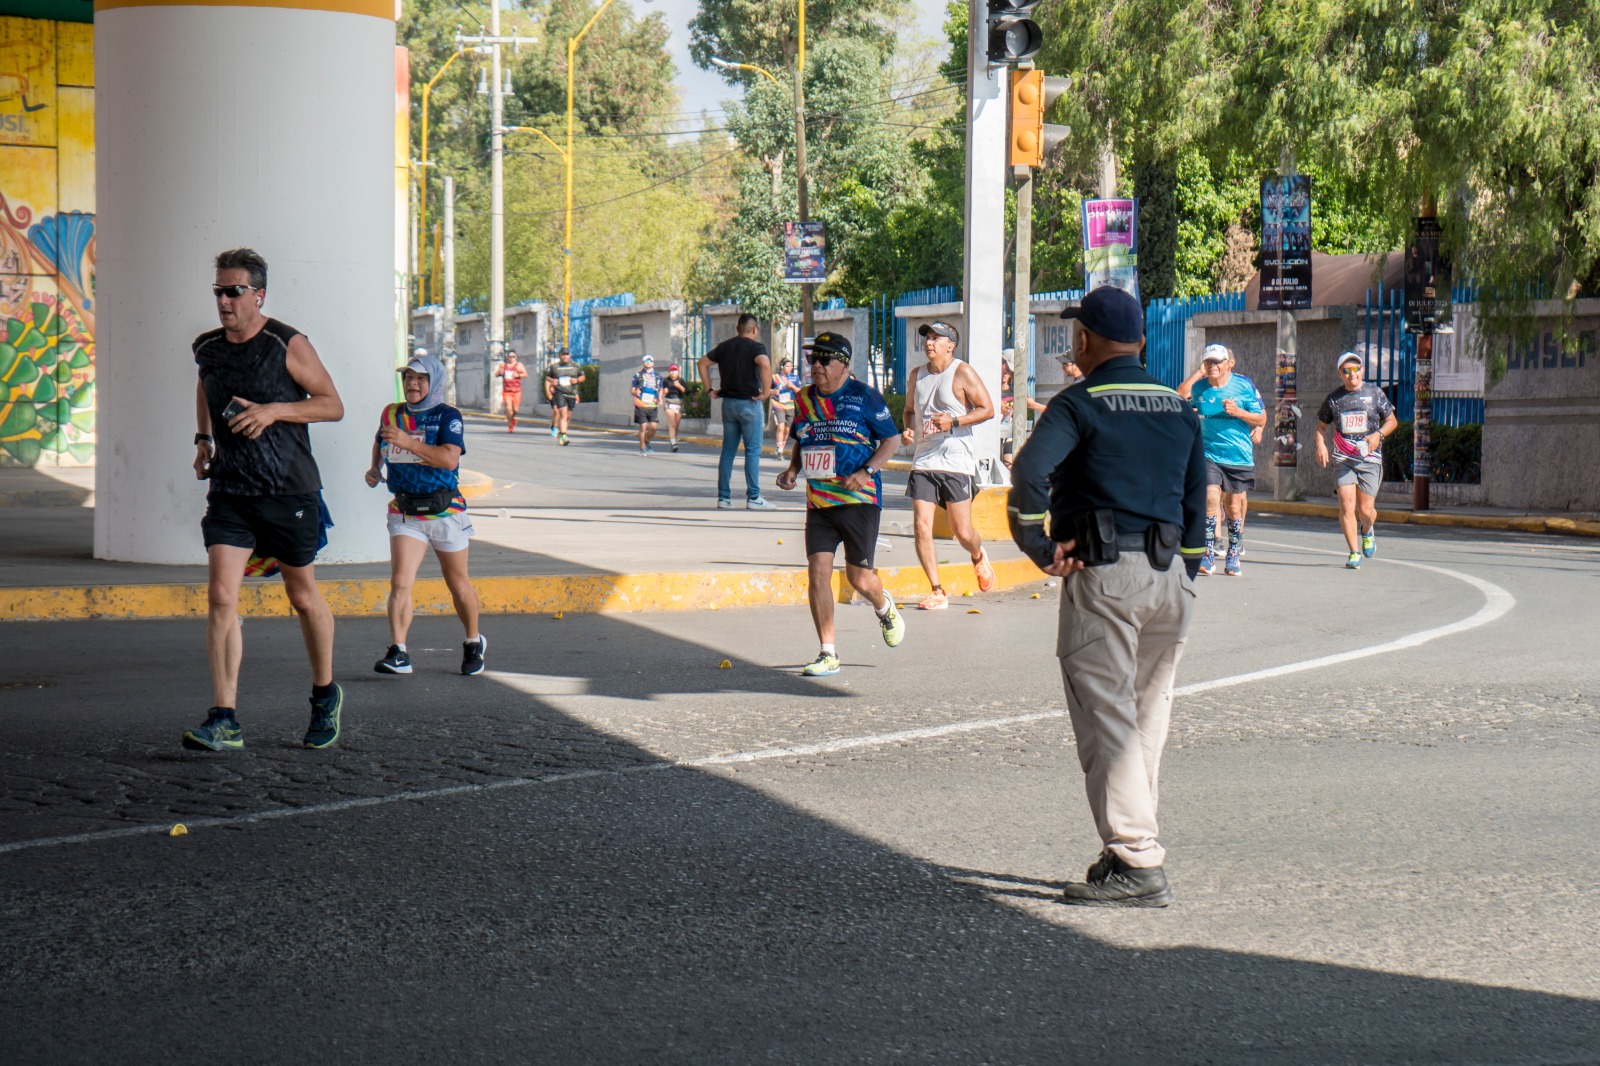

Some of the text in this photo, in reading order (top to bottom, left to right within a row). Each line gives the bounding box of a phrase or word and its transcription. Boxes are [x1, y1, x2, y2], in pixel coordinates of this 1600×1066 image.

[1271, 278, 1276, 286] 8
[1283, 278, 1299, 286] JULIO
[1043, 325, 1071, 354] UASL
[1507, 330, 1596, 369] UASLP
[1103, 394, 1183, 413] VIALIDAD
[828, 419, 858, 428] MARATÓN
[1345, 416, 1363, 428] 1918
[813, 426, 856, 434] TANGAMANGA
[815, 433, 831, 441] 2023
[804, 452, 831, 471] 1470
